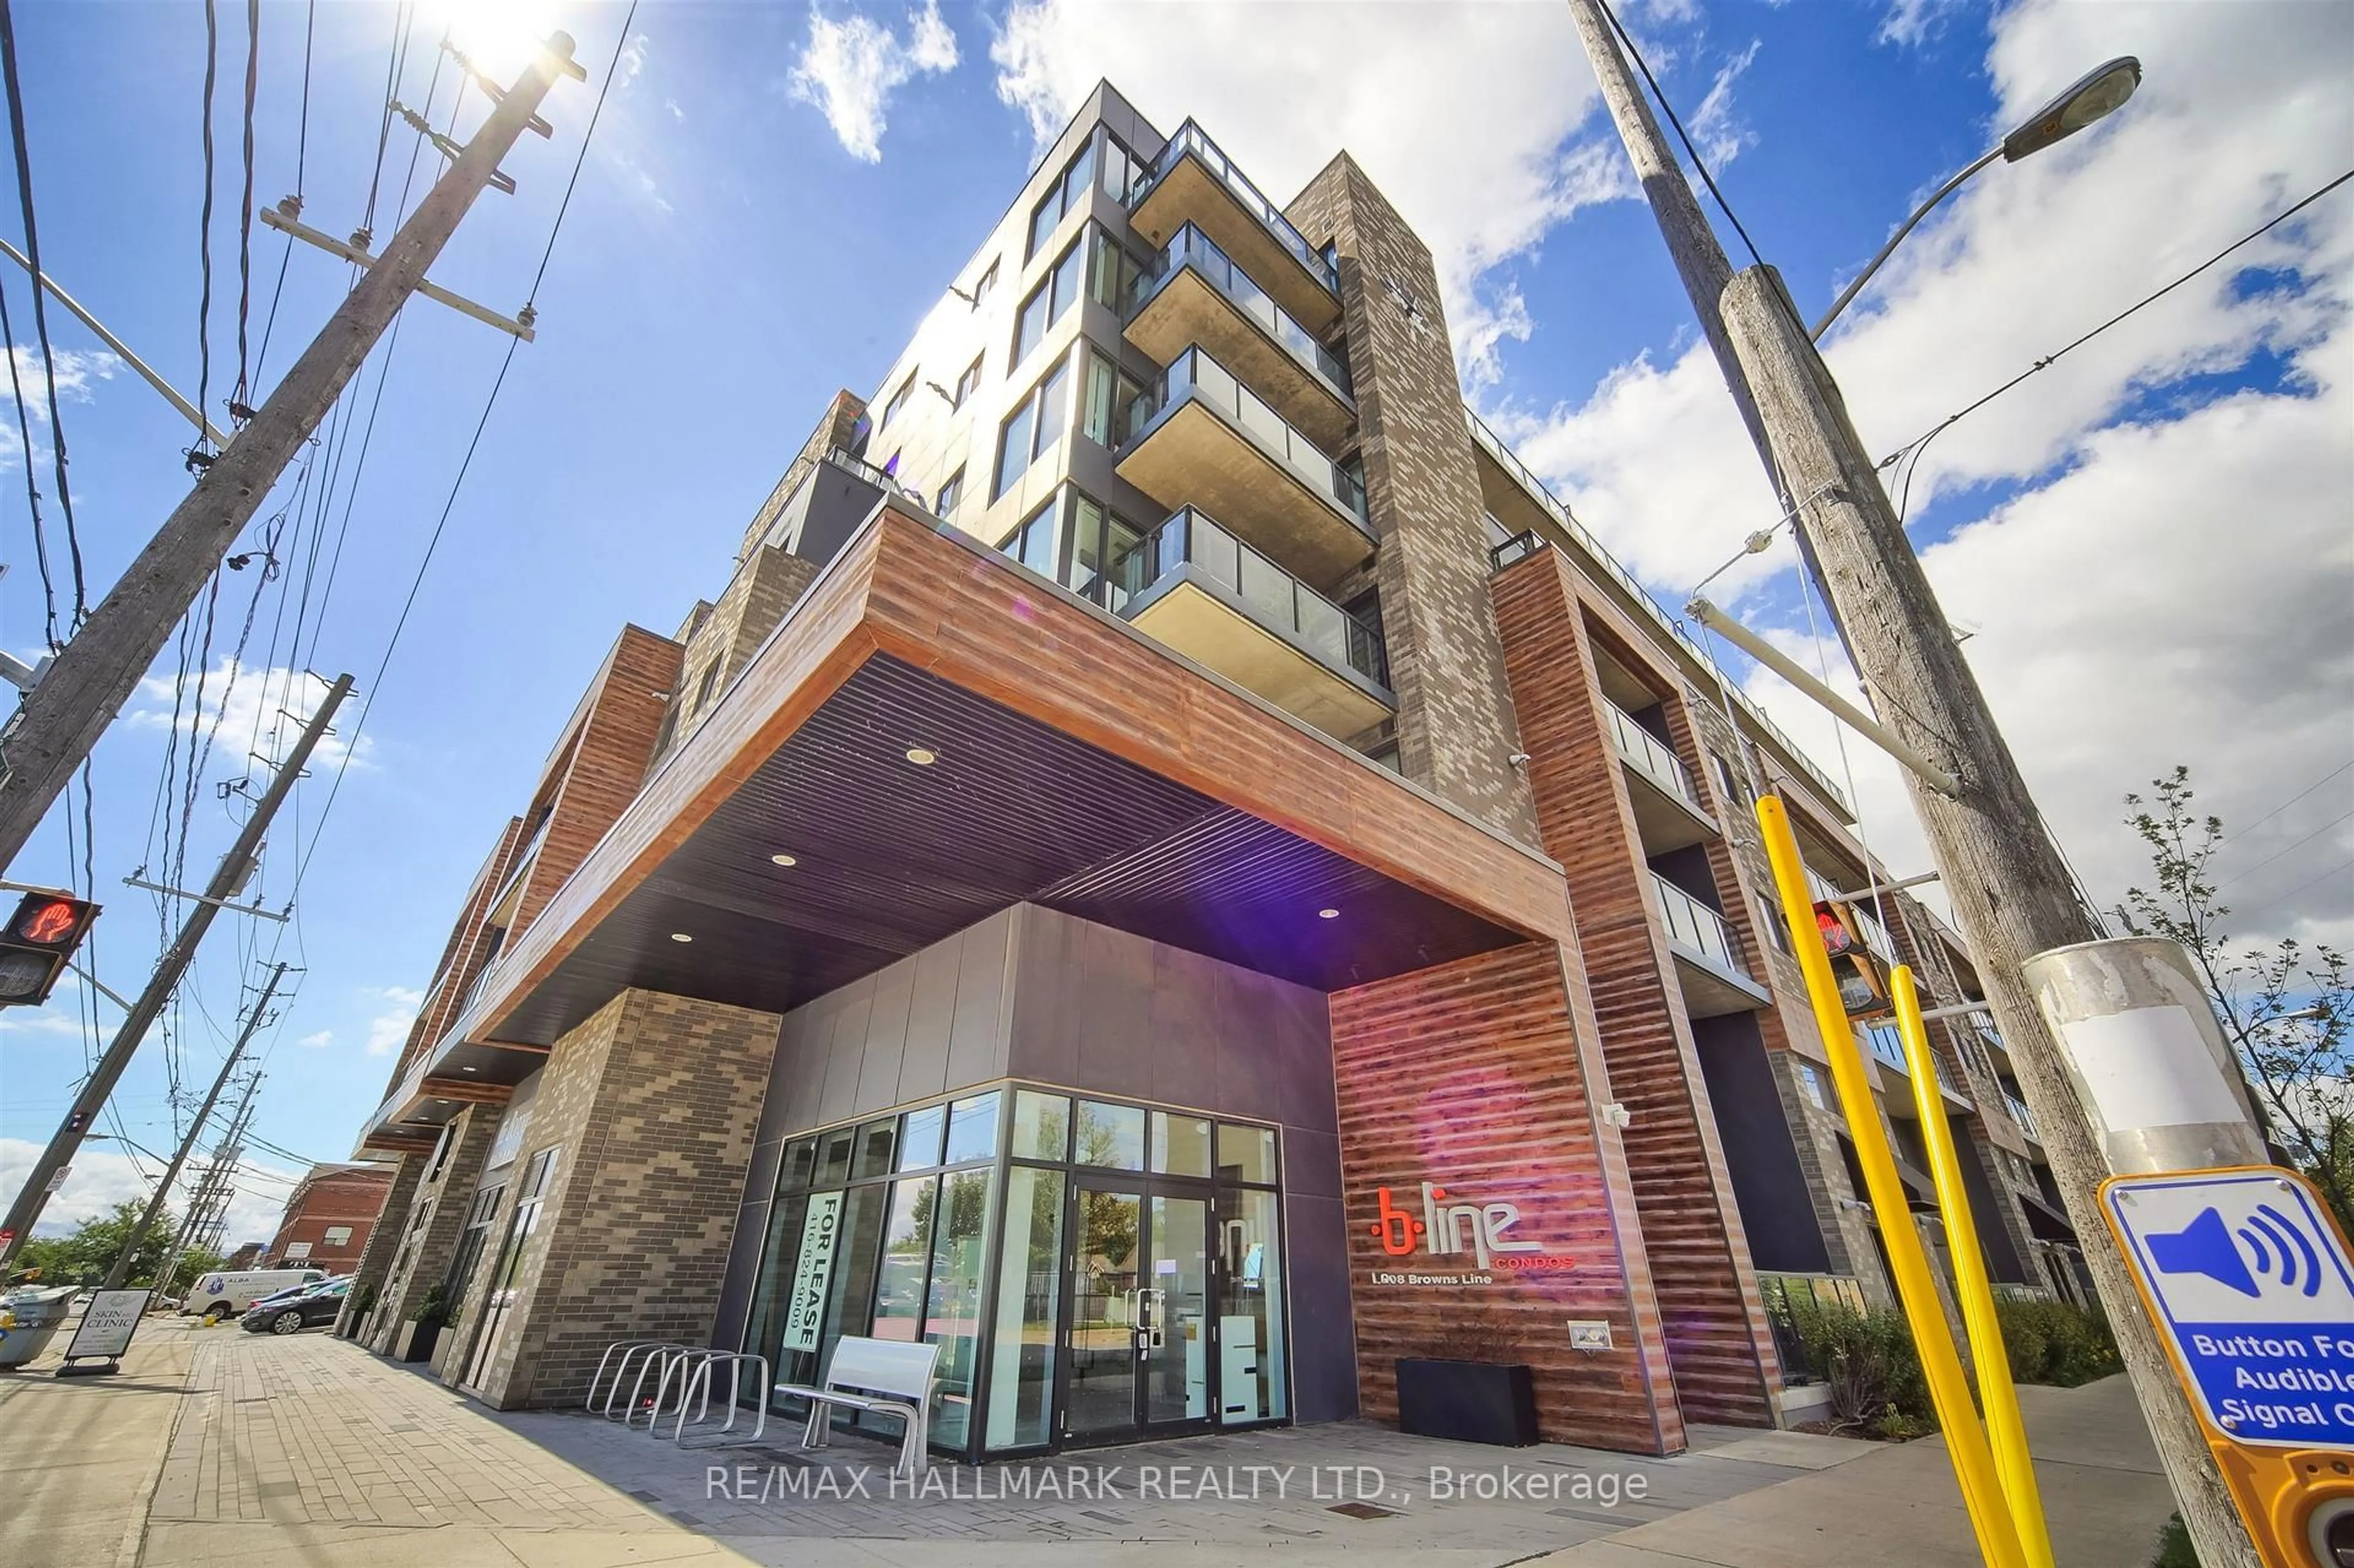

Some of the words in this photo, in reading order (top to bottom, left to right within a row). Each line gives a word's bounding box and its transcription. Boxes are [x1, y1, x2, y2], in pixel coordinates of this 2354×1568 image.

[817, 1199, 837, 1250] FOR
[1496, 1256, 1575, 1269] CONDOS
[1408, 1274, 1458, 1285] Browns
[1461, 1273, 1492, 1285] Line
[799, 1258, 827, 1344] LEASE
[86, 1319, 134, 1328] CLINIC
[2192, 1334, 2308, 1358] Button
[2222, 1398, 2329, 1428] Signal
